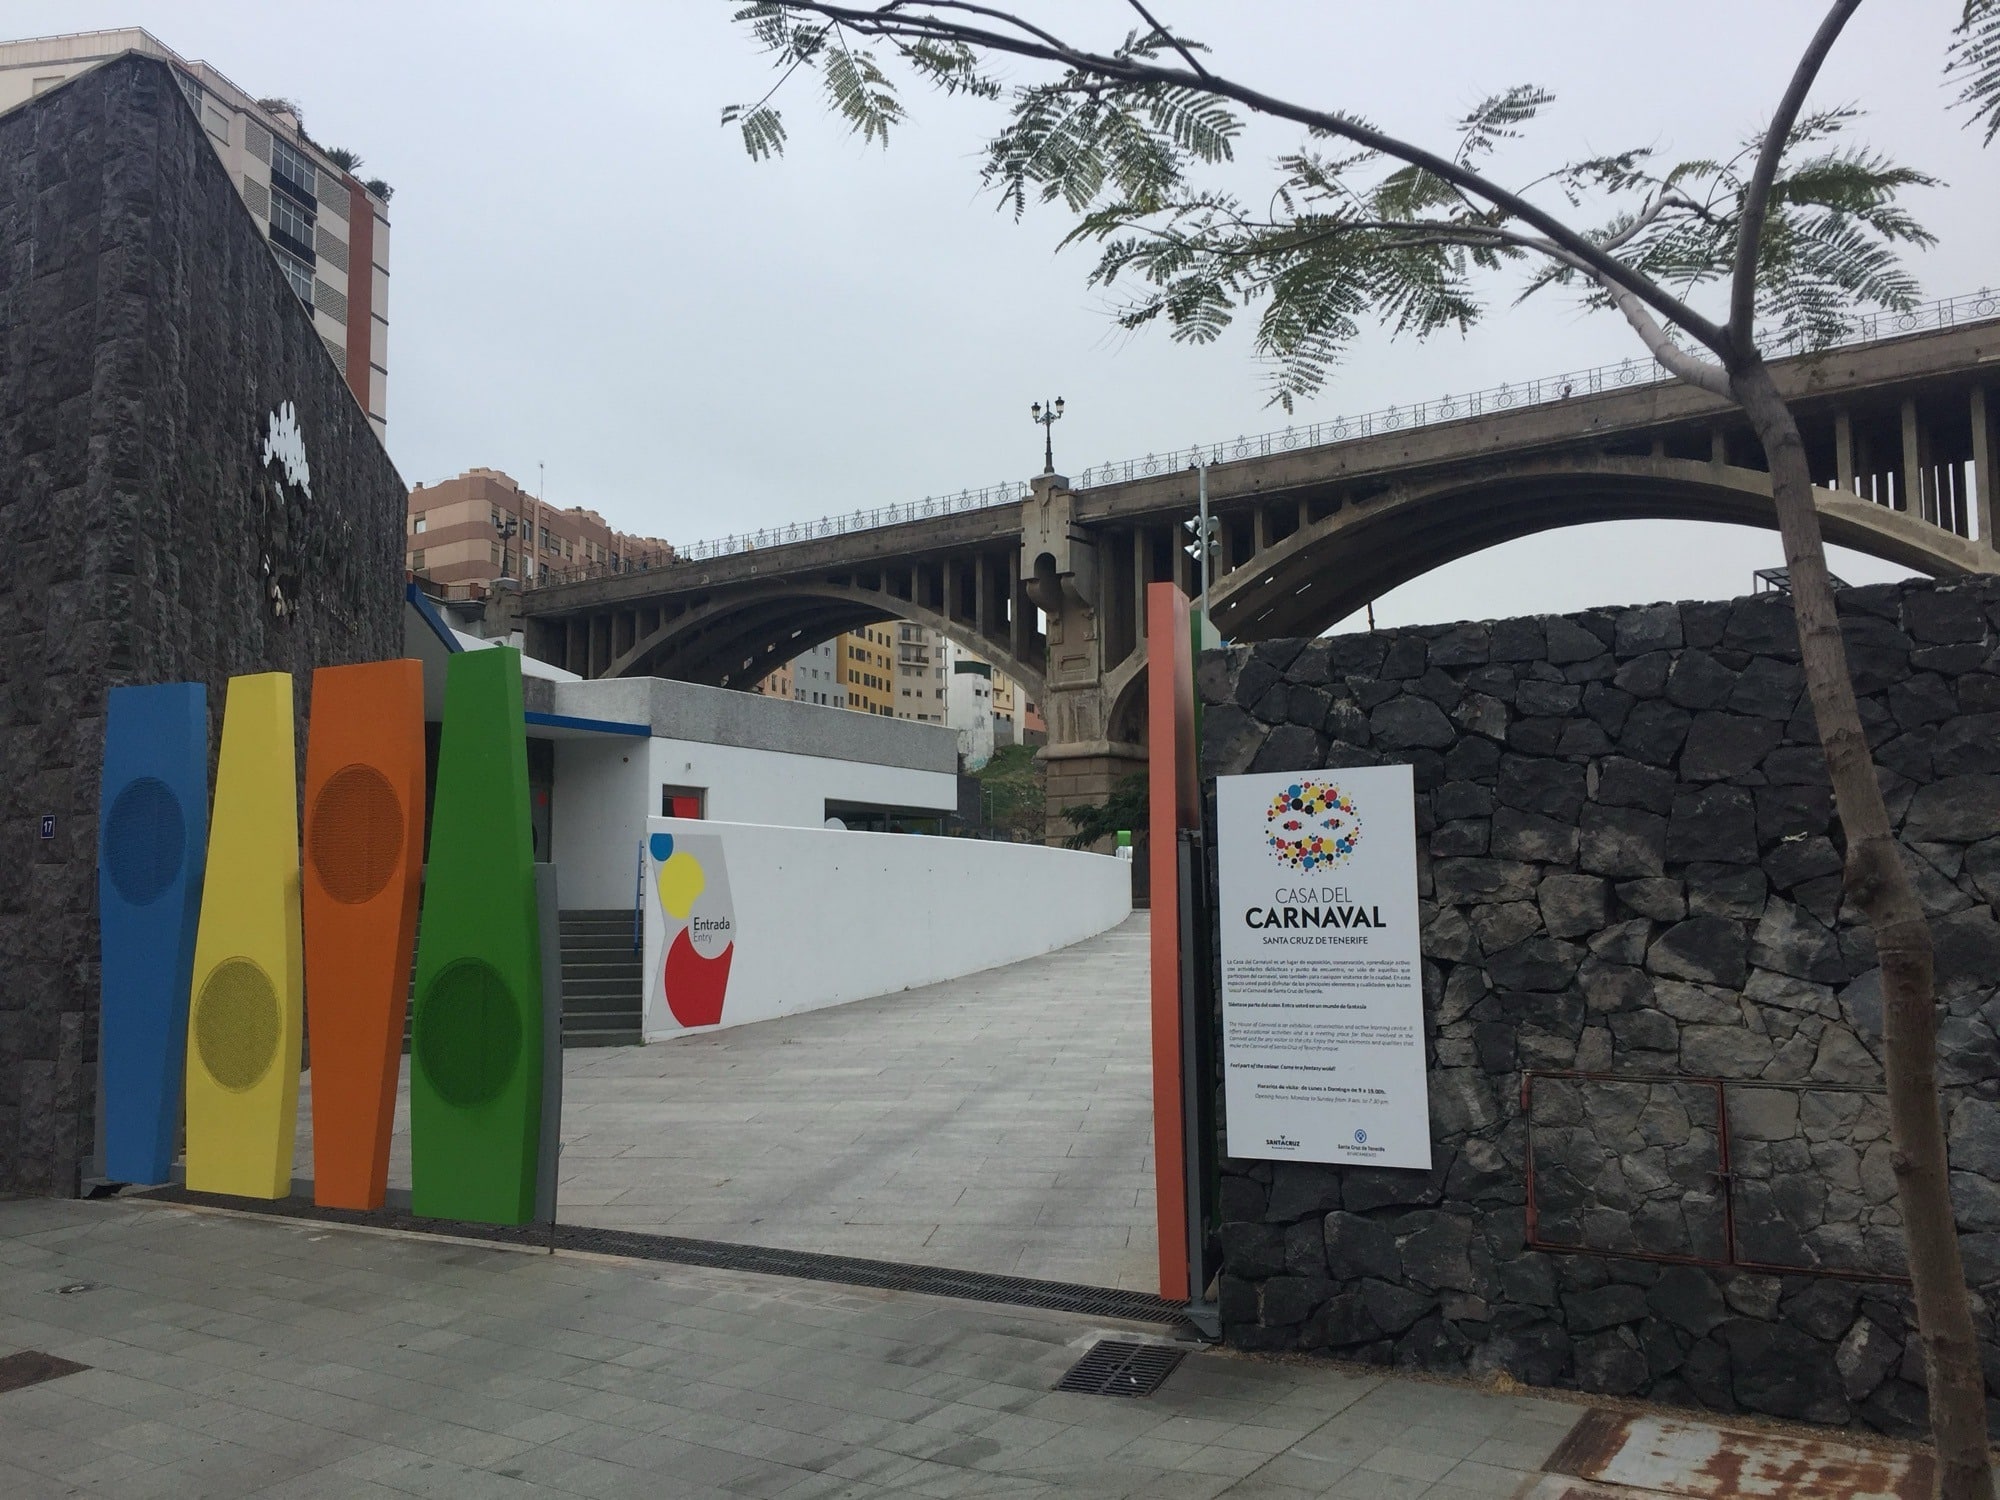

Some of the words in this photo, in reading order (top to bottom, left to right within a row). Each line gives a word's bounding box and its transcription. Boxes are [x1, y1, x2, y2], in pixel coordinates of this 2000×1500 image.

[43, 820, 53, 833] 17
[1275, 887, 1319, 904] CASA
[1322, 886, 1352, 903] DEL
[693, 916, 730, 931] Entrada
[1245, 905, 1387, 929] CARNAVAL
[693, 931, 712, 944] Entry
[1262, 936, 1289, 945] SANTA
[1289, 936, 1314, 945] CRUZ
[1315, 936, 1327, 945] DE
[1328, 936, 1369, 945] TENERIFE
[1266, 1139, 1300, 1147] SANTACRUZ
